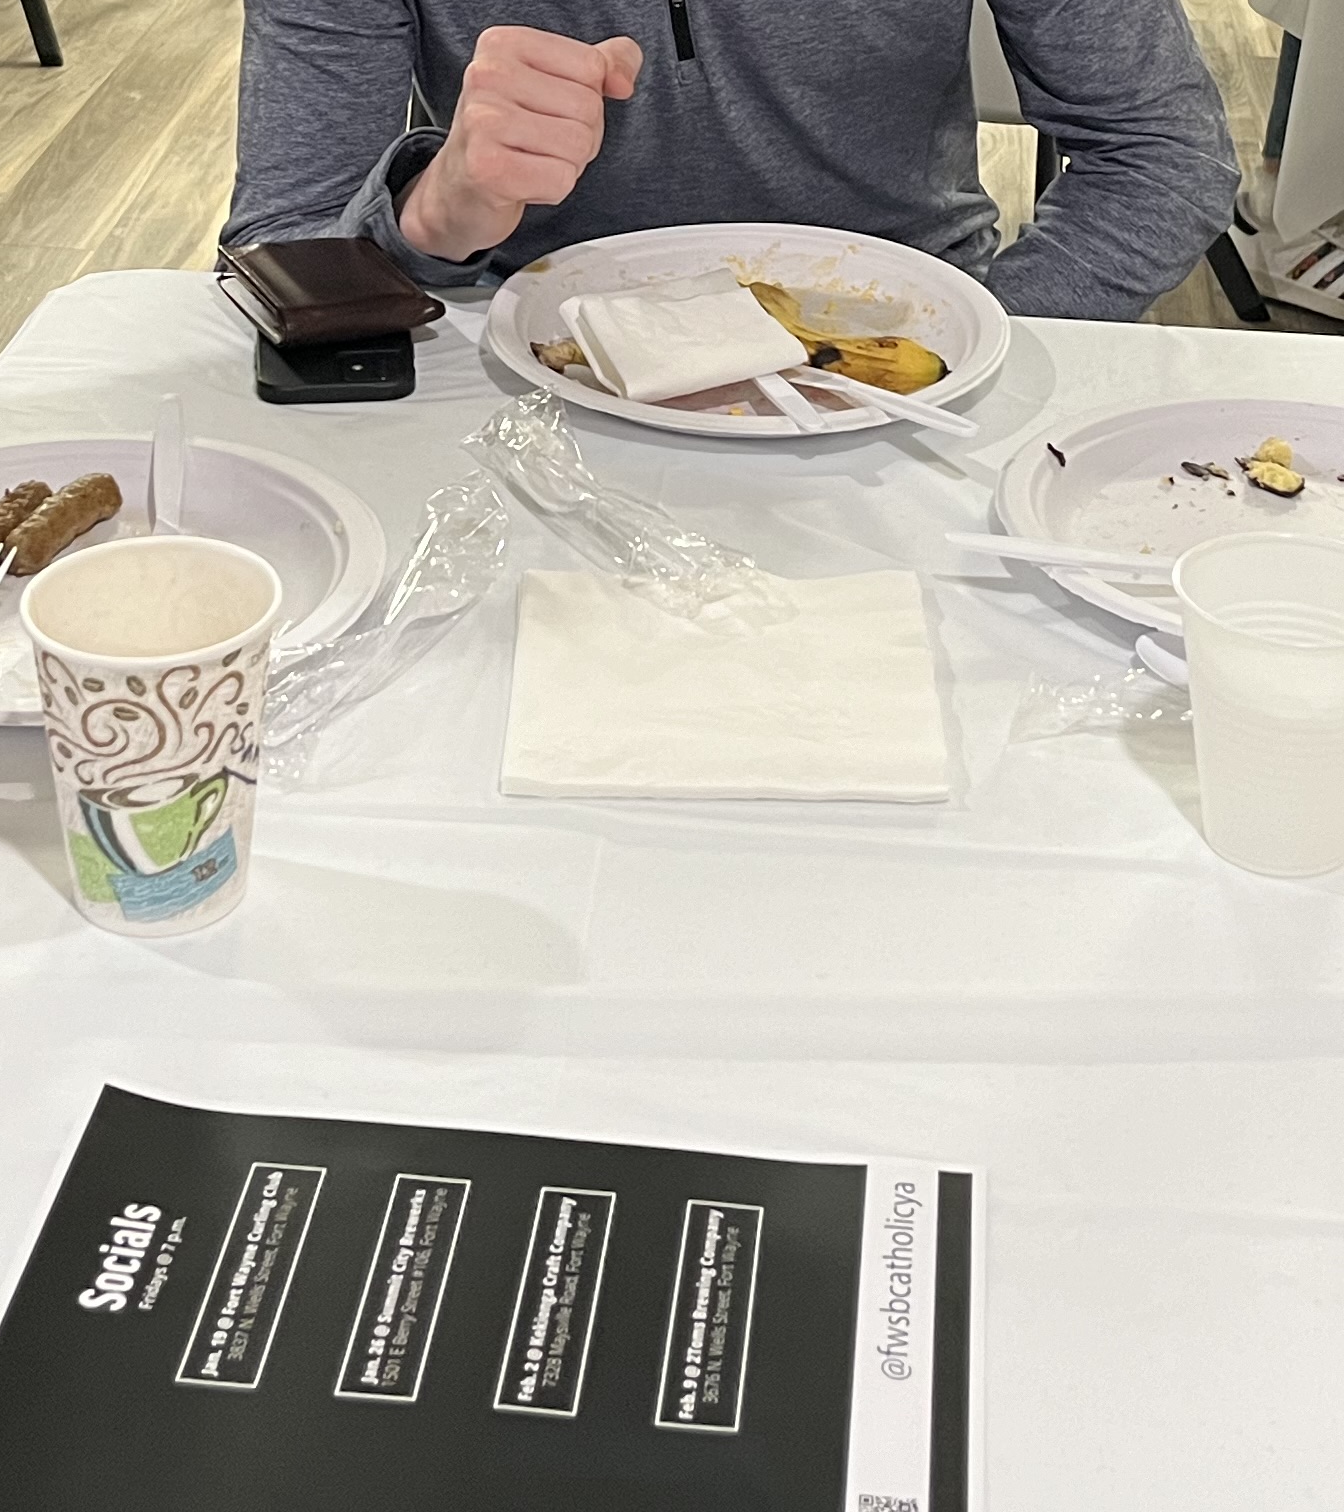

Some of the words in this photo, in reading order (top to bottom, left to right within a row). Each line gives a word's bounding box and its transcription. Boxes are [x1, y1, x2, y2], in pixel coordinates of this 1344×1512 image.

[262, 1171, 284, 1197] Club
[247, 1198, 278, 1242] Curling
[266, 1223, 287, 1245] Fort
[549, 1196, 577, 1254] Company
[419, 1224, 438, 1246] Fort
[700, 1208, 724, 1266] Company
[78, 1203, 162, 1311] Socials
[231, 1244, 258, 1287] Wayne
[392, 1246, 414, 1273] City
[542, 1255, 562, 1287] Craft
[565, 1250, 584, 1273] Fort
[138, 1266, 168, 1309] Fridays
[161, 1242, 176, 1251] 7
[717, 1264, 735, 1287] Fort
[876, 1181, 923, 1381] @fwsbcatholicya
[221, 1289, 243, 1315] Fort
[377, 1274, 404, 1324] Summit
[692, 1267, 717, 1320] Brewing
[211, 1330, 228, 1347] 19
[368, 1338, 386, 1355] 26
[201, 1350, 223, 1377] Jan.
[361, 1356, 381, 1385] Jan.
[524, 1362, 540, 1372] 2
[517, 1373, 537, 1401] Feb.
[683, 1379, 698, 1389] 9
[678, 1390, 697, 1420] Feb.
